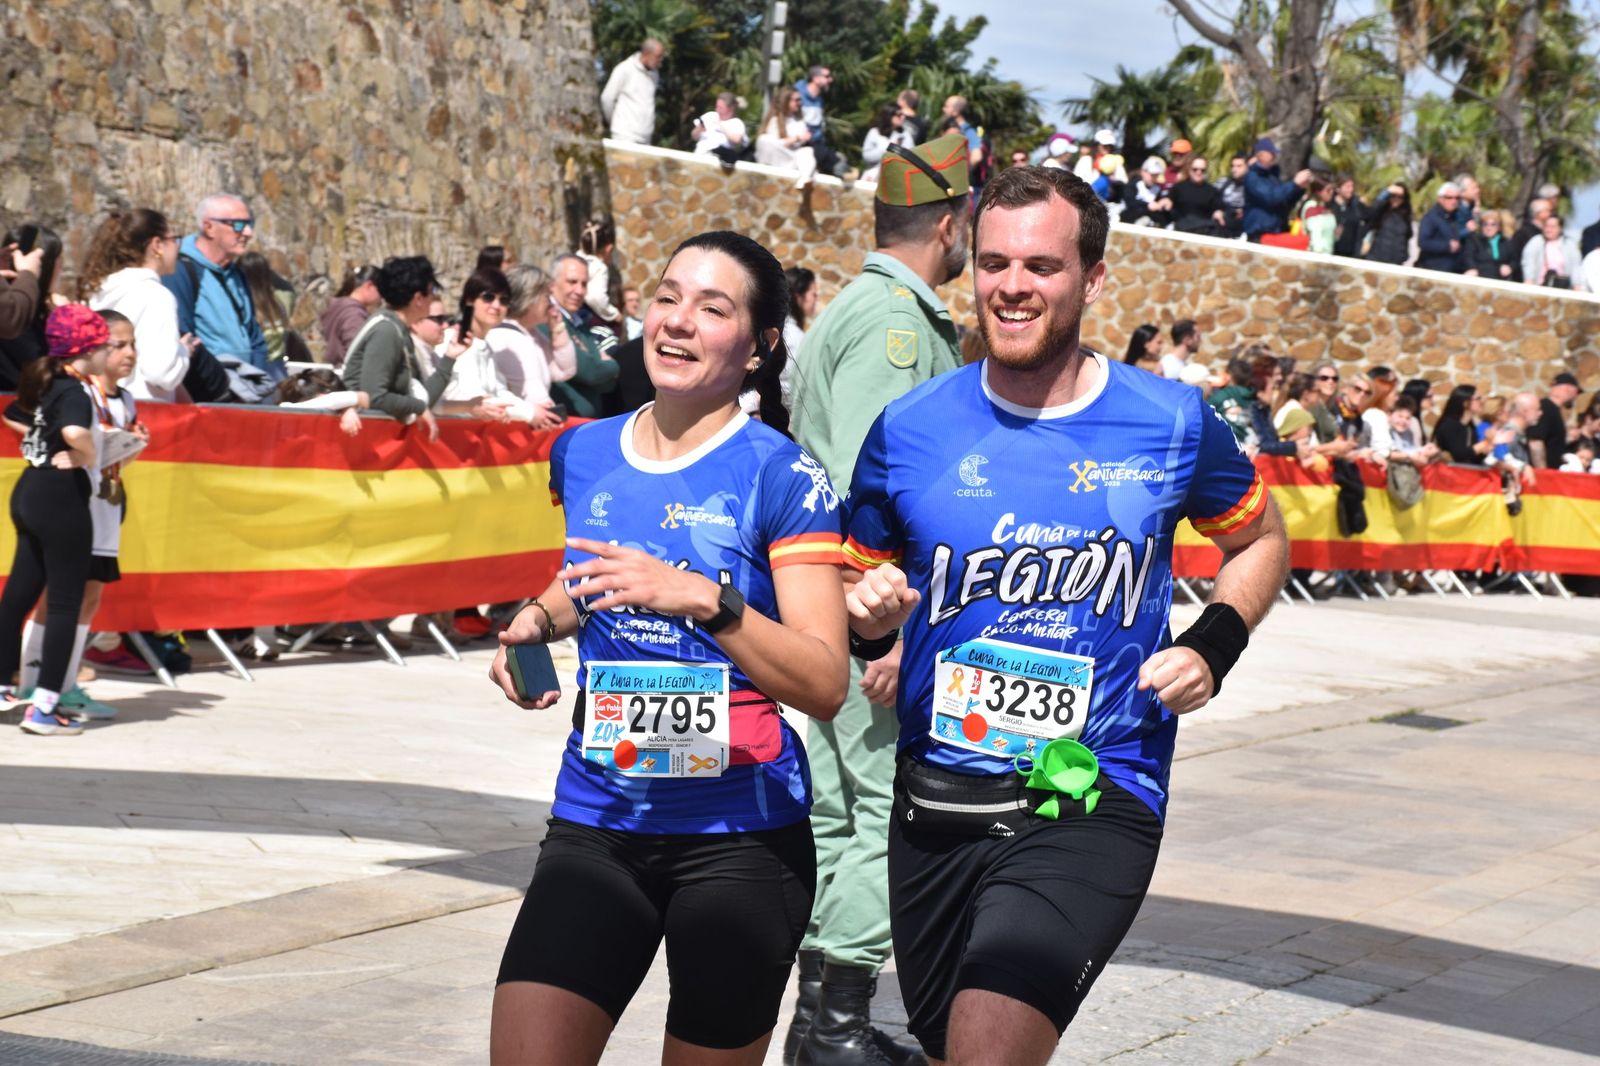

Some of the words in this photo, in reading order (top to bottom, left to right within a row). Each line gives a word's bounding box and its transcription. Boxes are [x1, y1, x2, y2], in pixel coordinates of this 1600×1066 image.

[991, 512, 1065, 544] Cuna
[928, 526, 1154, 629] LEGIÓN
[593, 671, 606, 688] X
[629, 695, 716, 735] 2795
[985, 675, 1076, 726] 3238
[591, 721, 626, 743] 20K
[998, 715, 1023, 726] SERGIO
